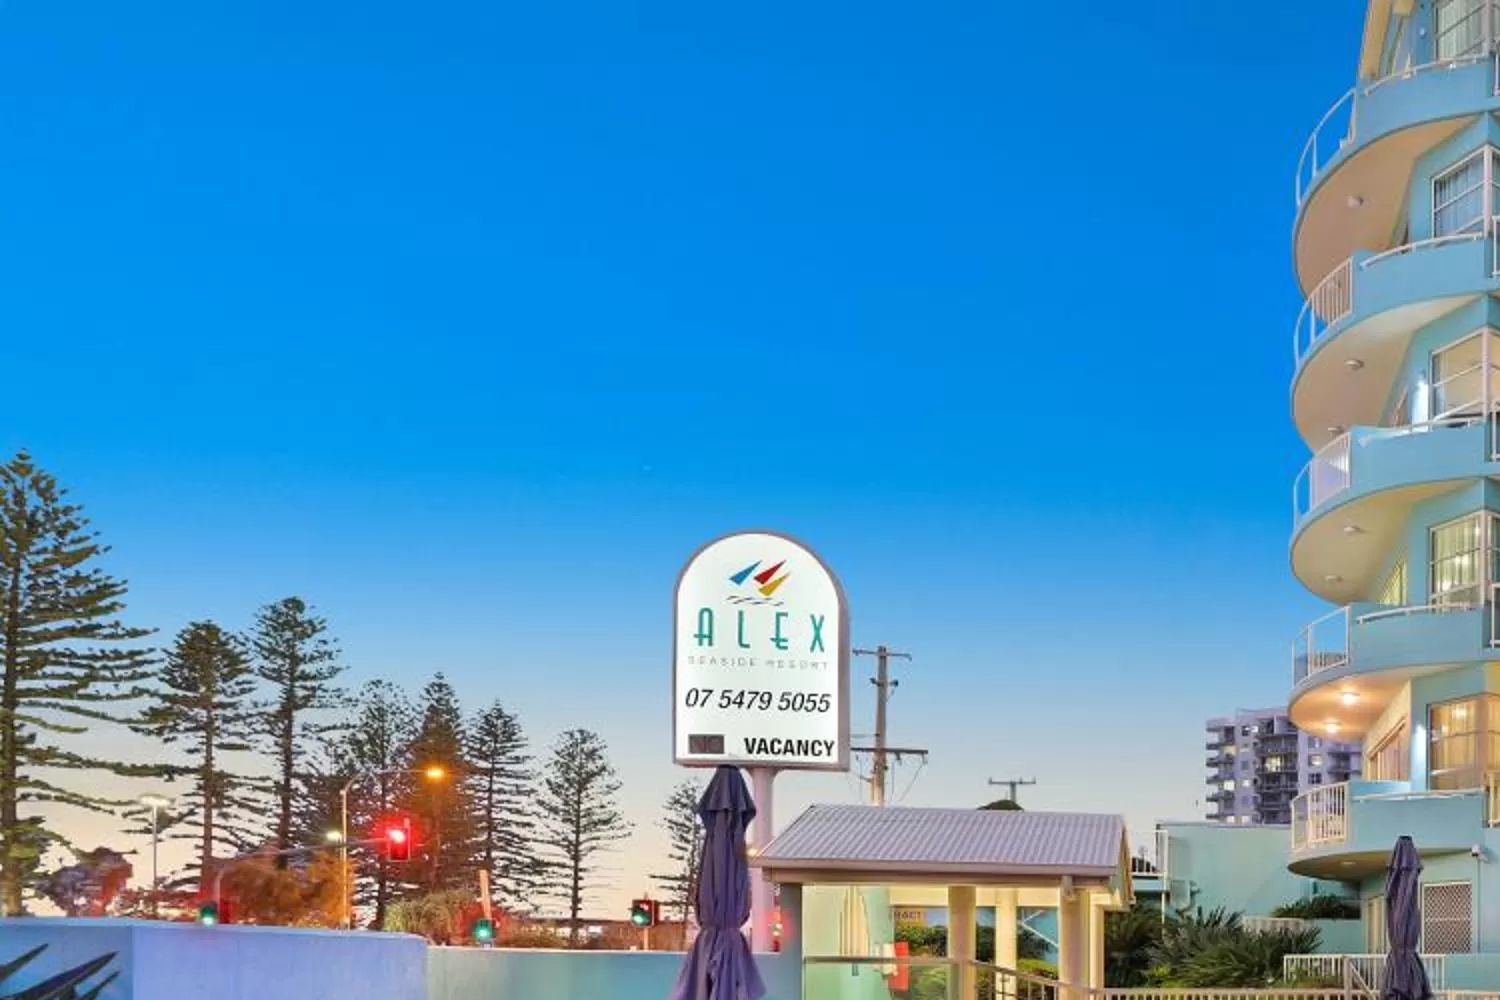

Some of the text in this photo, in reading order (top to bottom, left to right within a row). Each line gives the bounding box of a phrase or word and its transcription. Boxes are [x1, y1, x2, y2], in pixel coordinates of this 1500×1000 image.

[693, 607, 825, 652] ALEX
[687, 655, 756, 668] SEASIDE
[685, 687, 832, 713] 07 5479 5055
[743, 737, 835, 757] VACANCY
